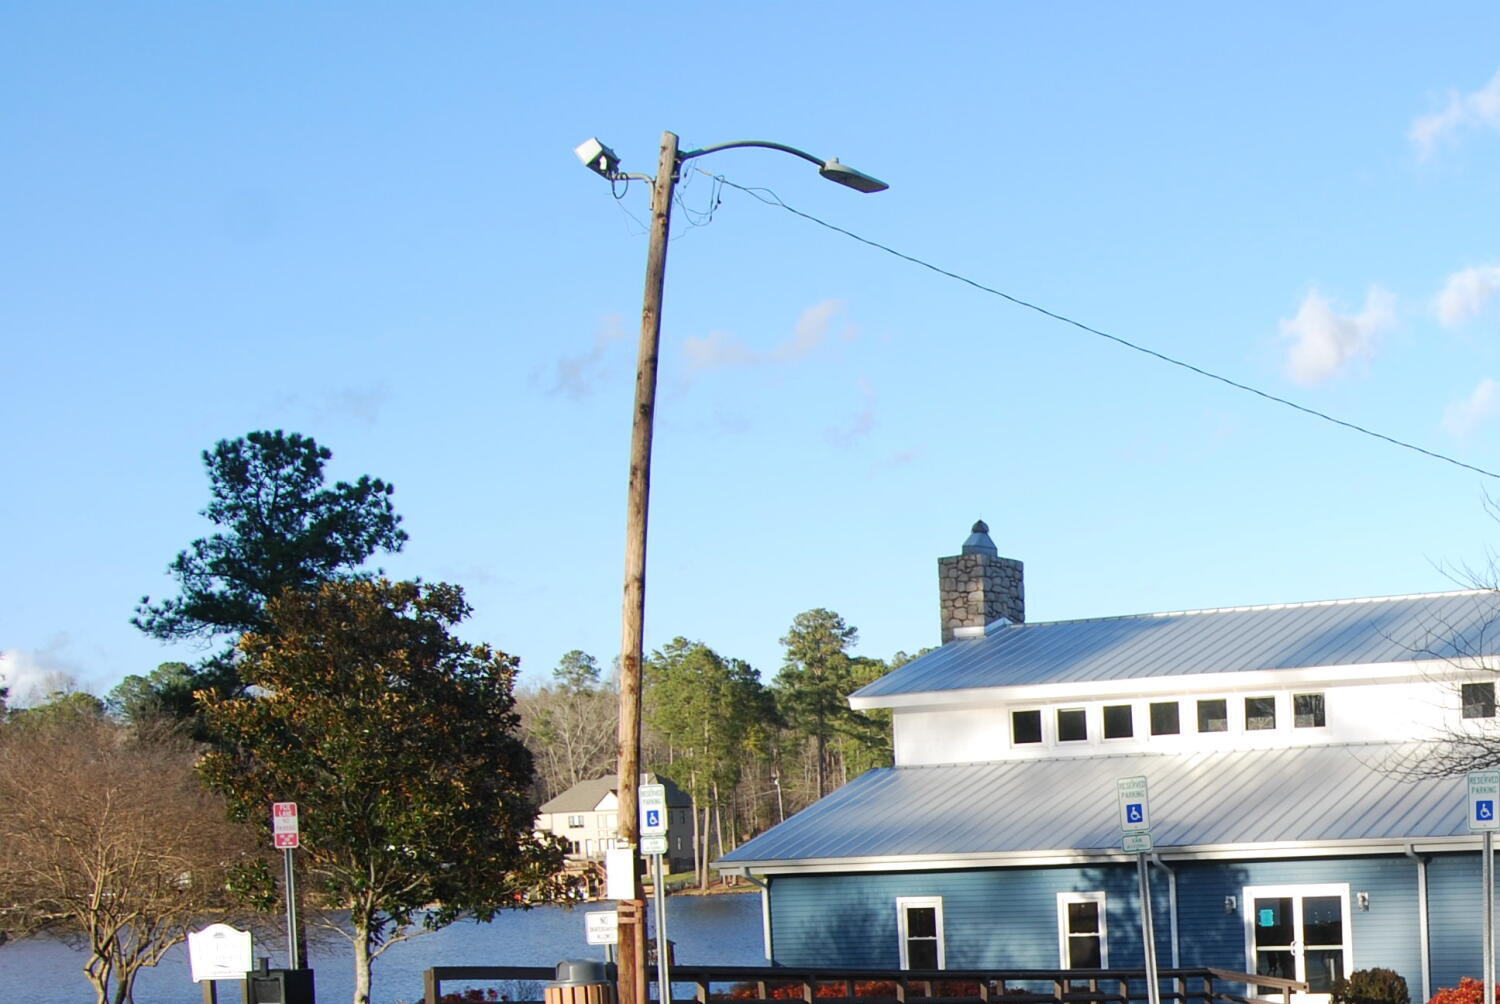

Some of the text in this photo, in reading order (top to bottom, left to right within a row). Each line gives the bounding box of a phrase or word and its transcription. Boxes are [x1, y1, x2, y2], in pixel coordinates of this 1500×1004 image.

[1470, 776, 1499, 784] RESERVED
[1119, 781, 1145, 790] RESERVED
[640, 789, 664, 797] RESERVED
[1121, 790, 1145, 798] PARKING
[1472, 786, 1496, 794] PARKING
